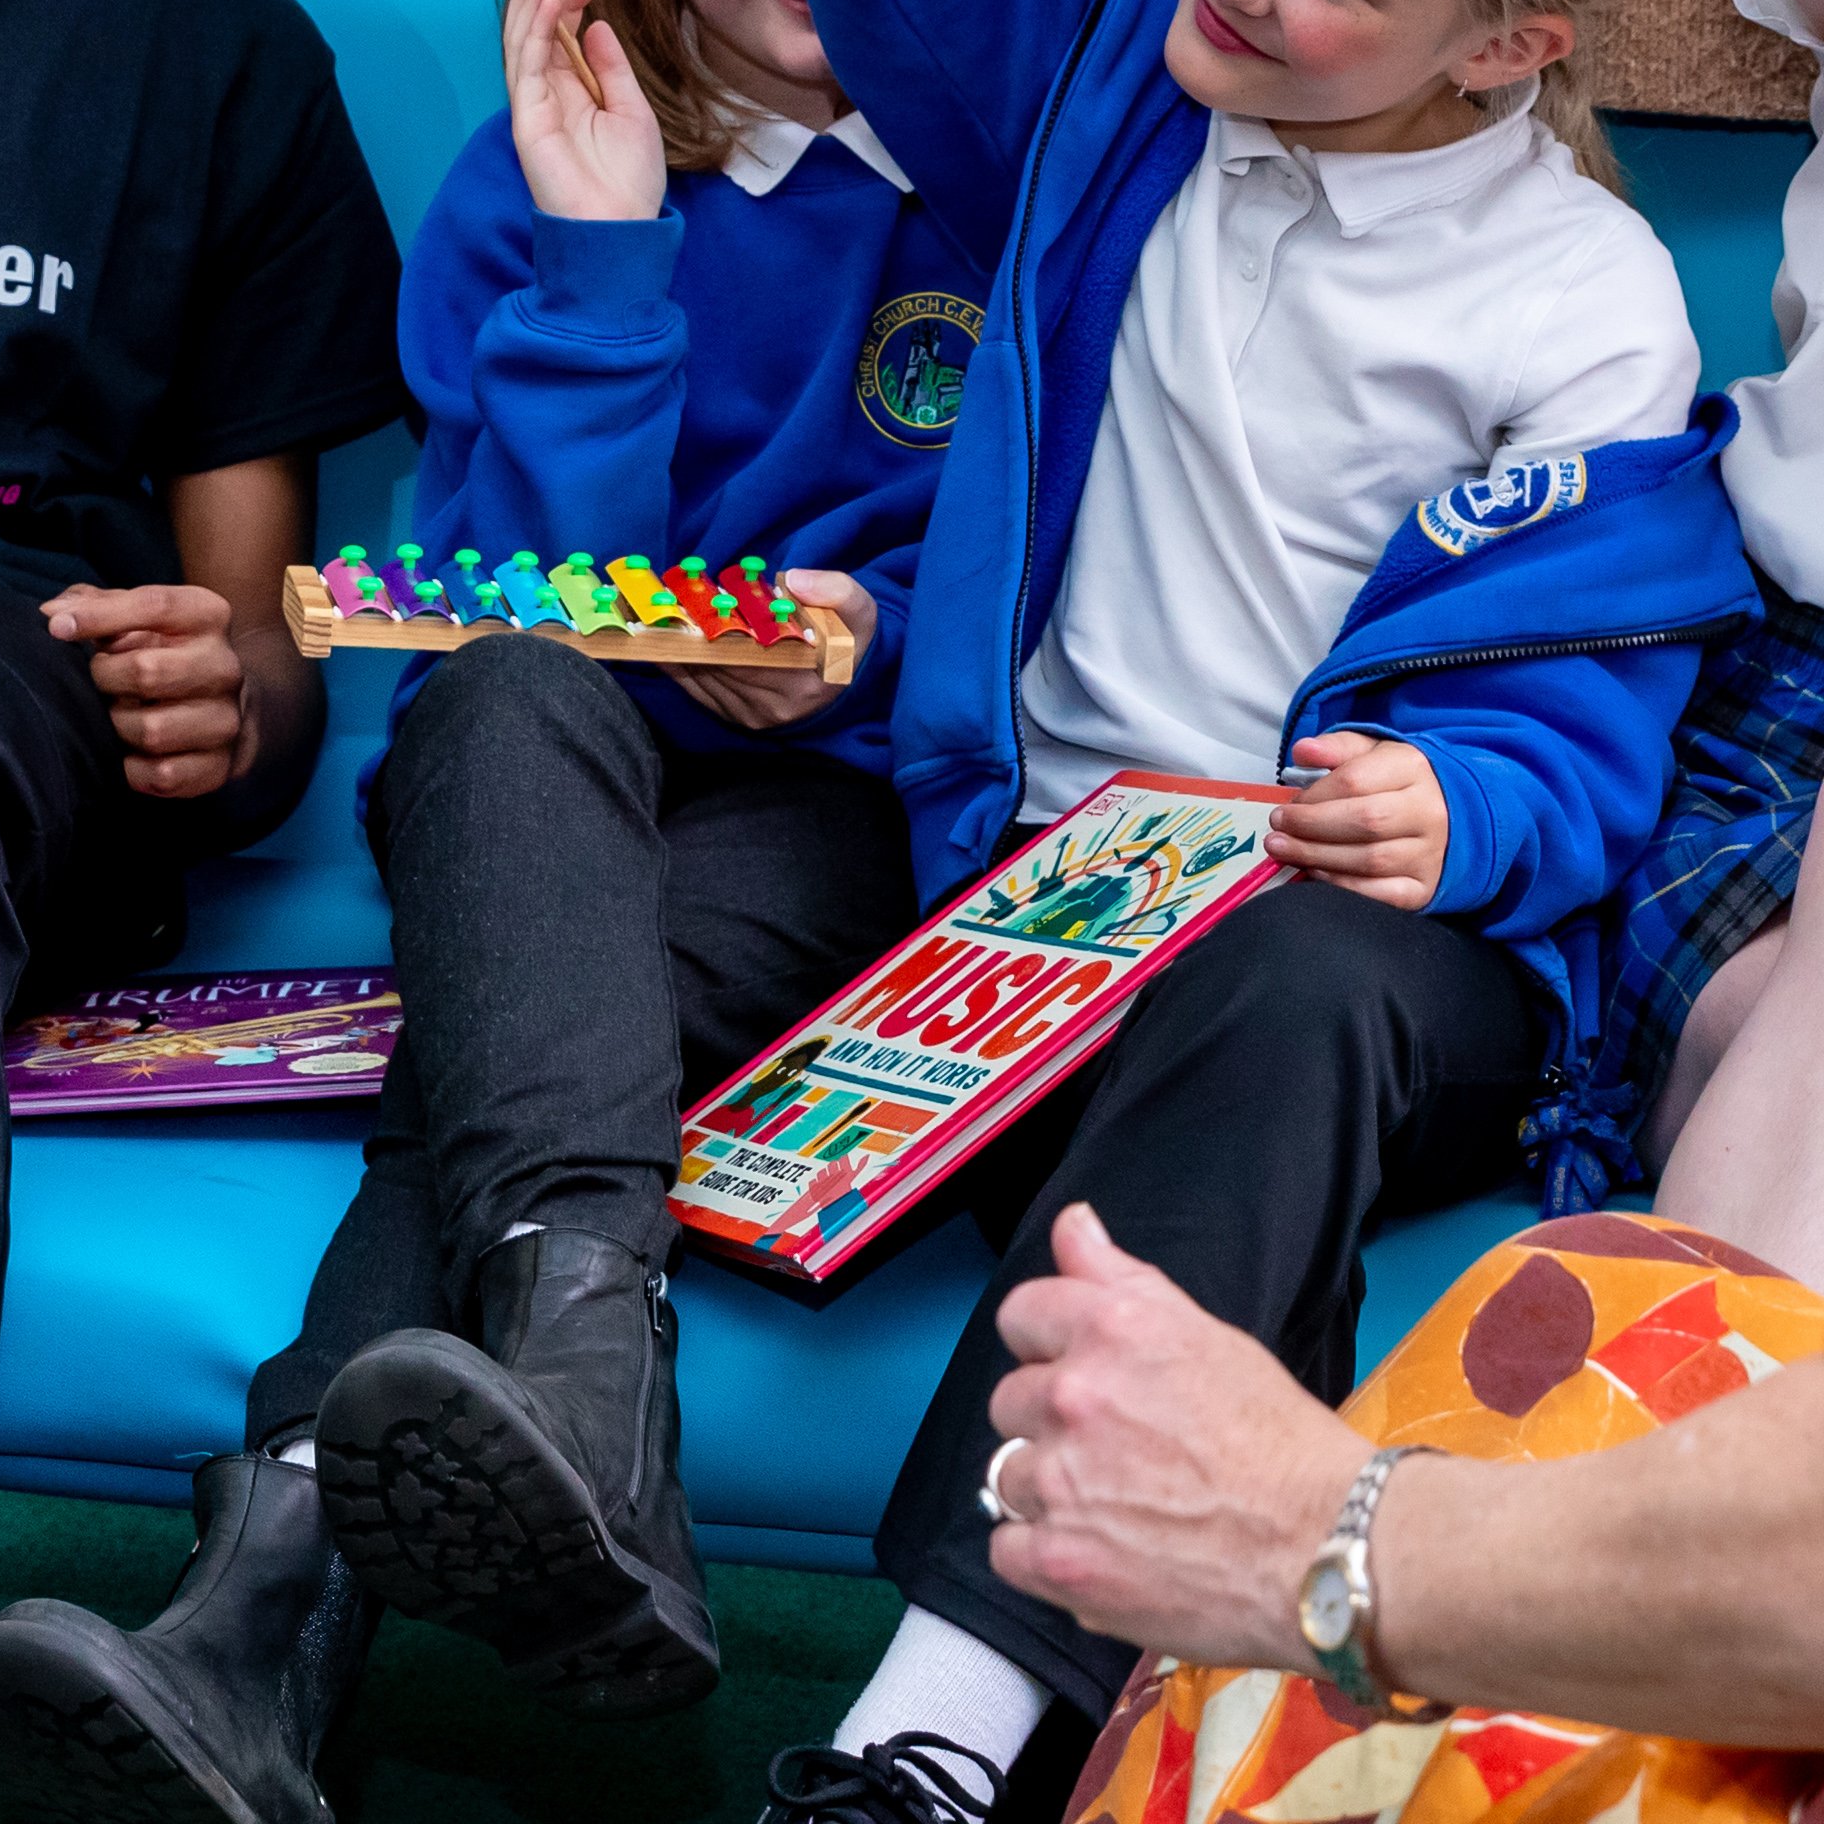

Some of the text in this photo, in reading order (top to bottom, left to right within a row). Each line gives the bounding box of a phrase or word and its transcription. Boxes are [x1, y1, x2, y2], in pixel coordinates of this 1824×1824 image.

[859, 334, 879, 398] CHRIST
[872, 297, 940, 336] CHURCH
[84, 977, 385, 1008] TRUMPET
[828, 935, 1113, 1061] MUSIC
[825, 1037, 991, 1091] AND HOW IT WORKS
[697, 1169, 784, 1206] GUIDE FOR KIDS
[725, 1147, 813, 1184] THE COMPLETE
